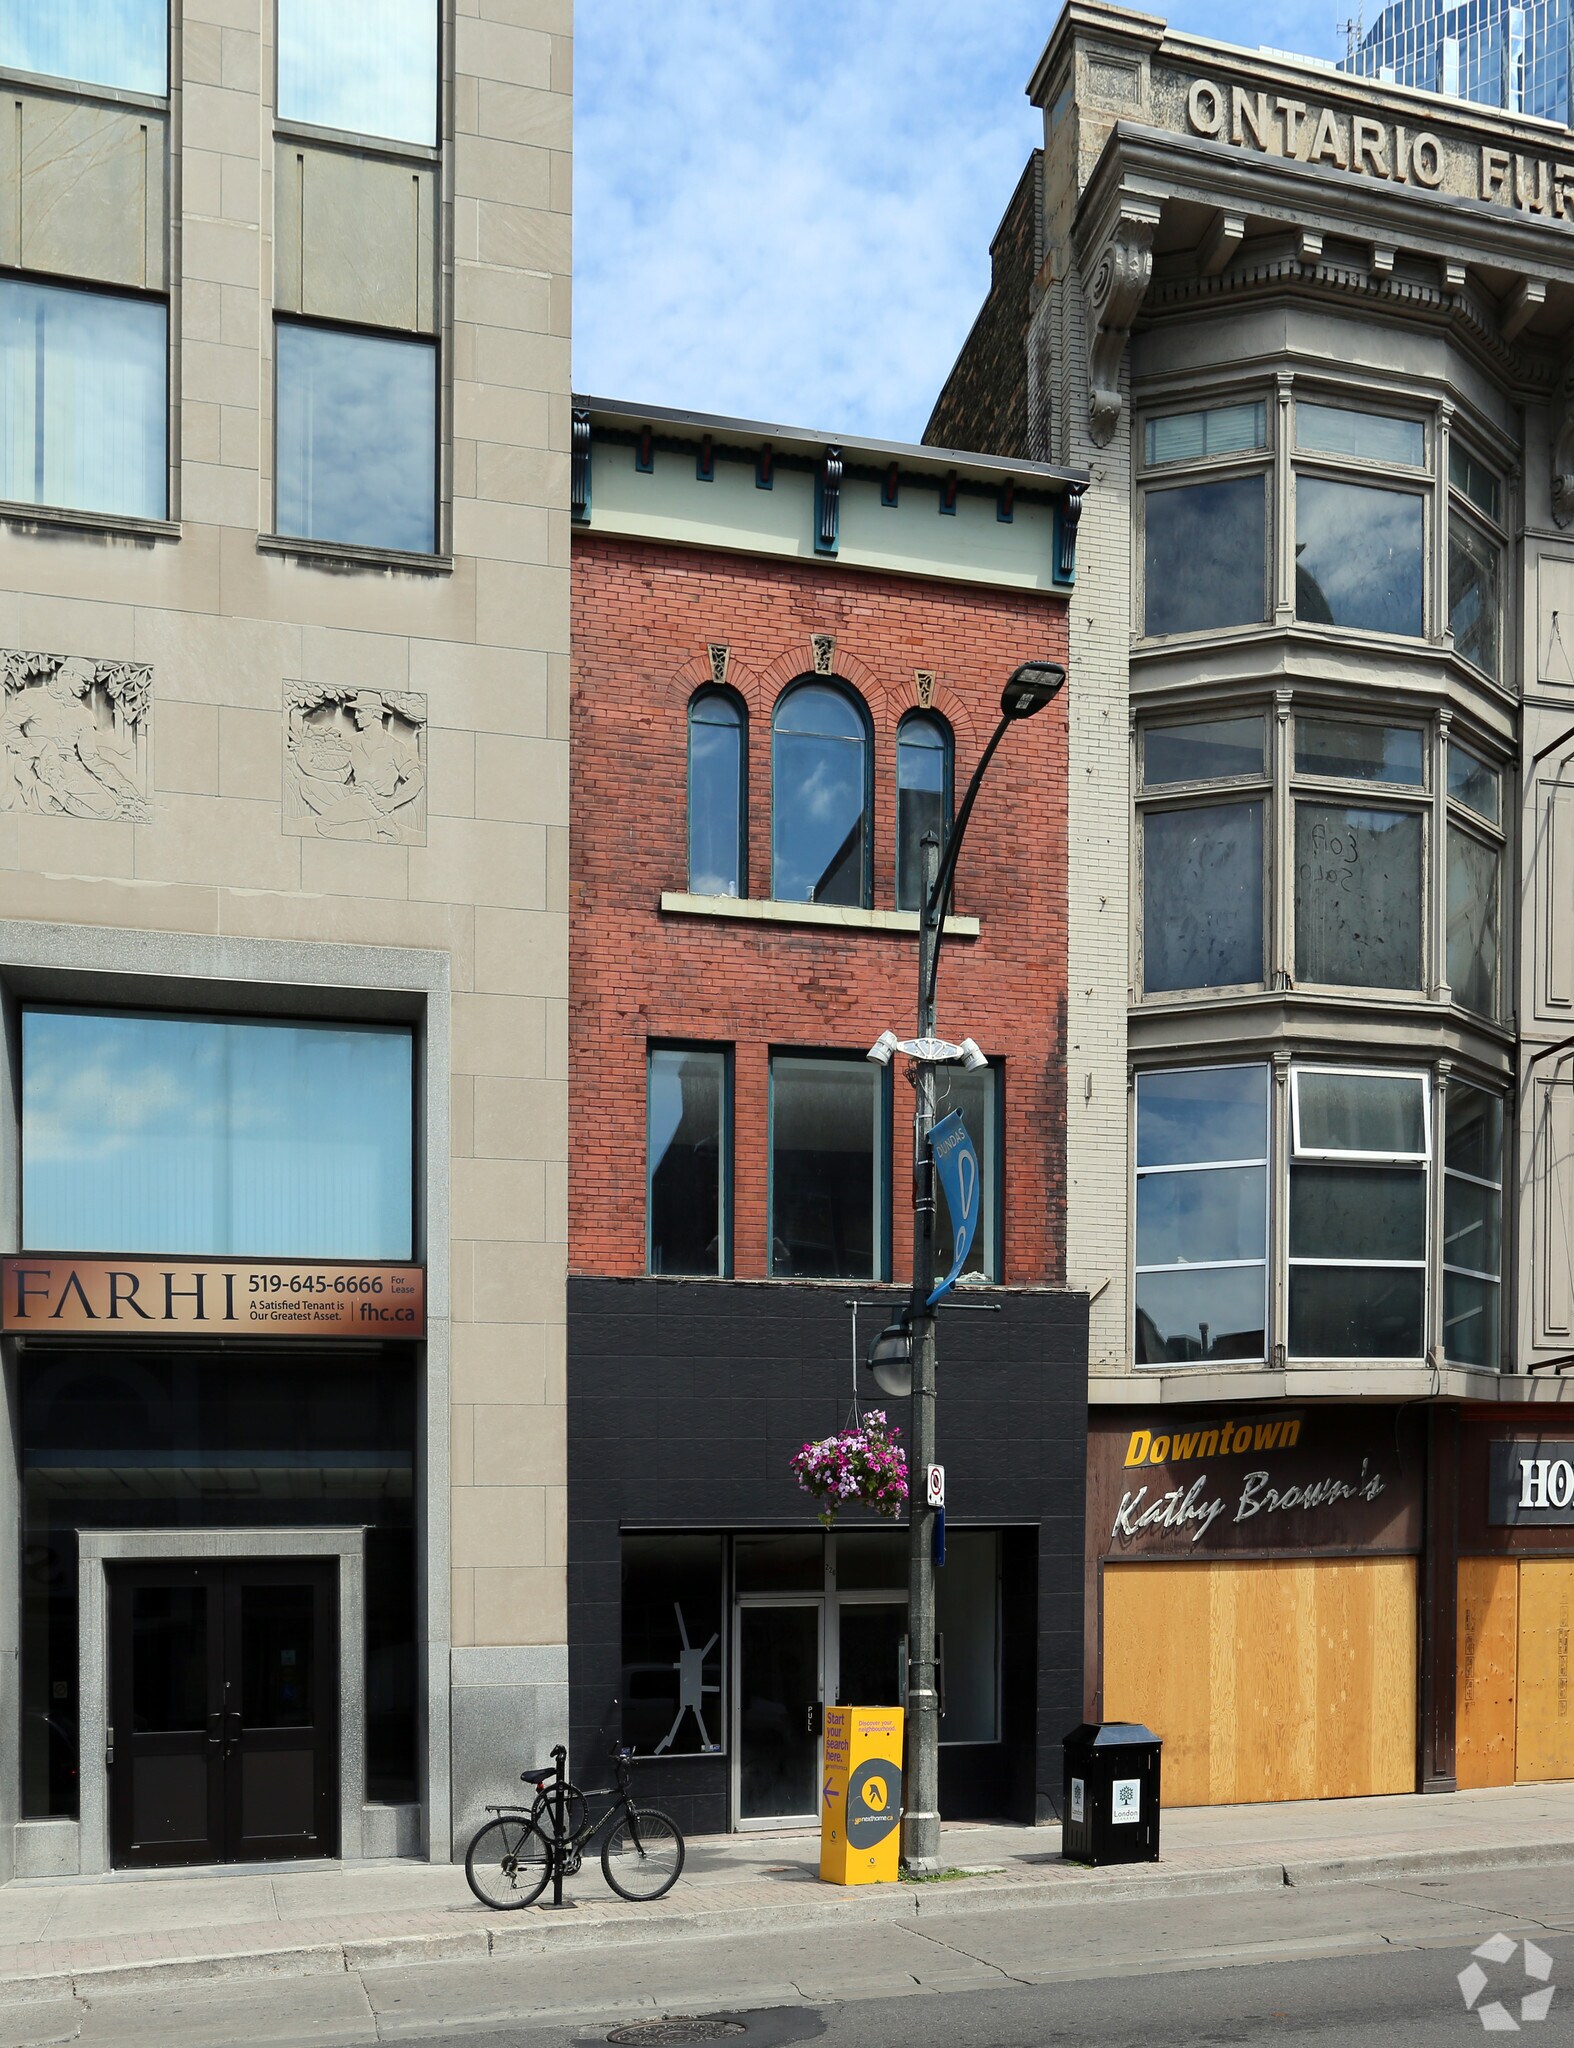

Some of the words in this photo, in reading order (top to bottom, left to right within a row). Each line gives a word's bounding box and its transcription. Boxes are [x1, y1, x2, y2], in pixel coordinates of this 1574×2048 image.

[1187, 79, 1445, 188] ONTARIO
[936, 1127, 965, 1158] DUNDAS
[248, 1274, 384, 1293] 519-645-6666
[391, 1276, 405, 1284] For
[12, 1269, 239, 1321] FARHI
[391, 1285, 415, 1294] Lease
[250, 1301, 256, 1310] A
[259, 1300, 300, 1310] Satisfied
[302, 1301, 335, 1310] Tenant
[337, 1301, 345, 1310] is
[250, 1311, 268, 1321] Our
[270, 1311, 313, 1321] Greatest
[313, 1312, 342, 1321] Asset.
[360, 1303, 415, 1322] fhc.ca
[1124, 1419, 1300, 1468] Downtown
[1518, 1460, 1574, 1508] HO
[1111, 1474, 1226, 1541] Kathy
[1233, 1457, 1387, 1523] Brown's
[827, 1712, 845, 1725] Start
[826, 1727, 842, 1738] your
[826, 1739, 849, 1751] search
[826, 1749, 843, 1762] here.
[1113, 1809, 1138, 1818] London
